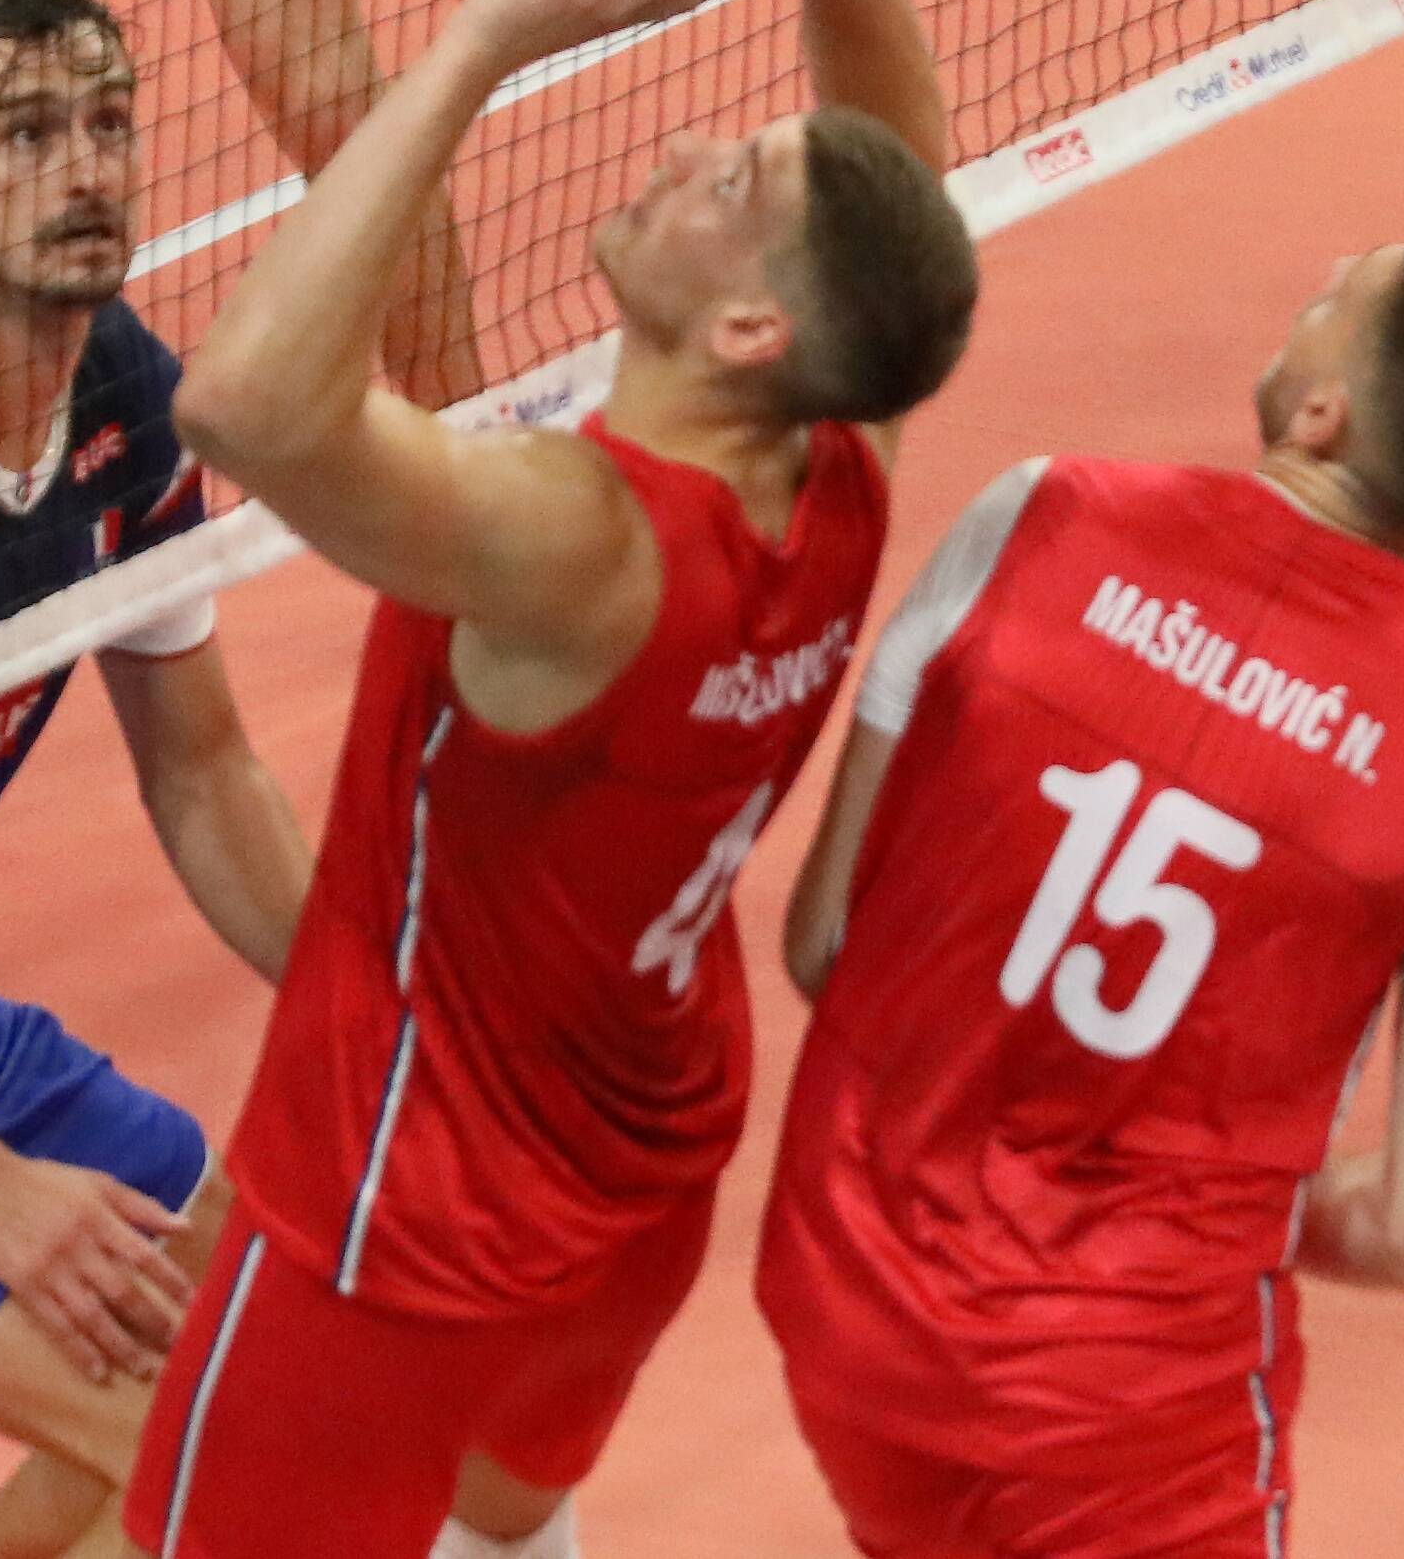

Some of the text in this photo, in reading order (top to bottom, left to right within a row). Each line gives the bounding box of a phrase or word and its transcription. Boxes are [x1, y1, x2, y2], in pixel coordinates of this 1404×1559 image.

[1082, 575, 1386, 786] MAŠULOVIĆ N.
[1000, 758, 1263, 1061] 15
